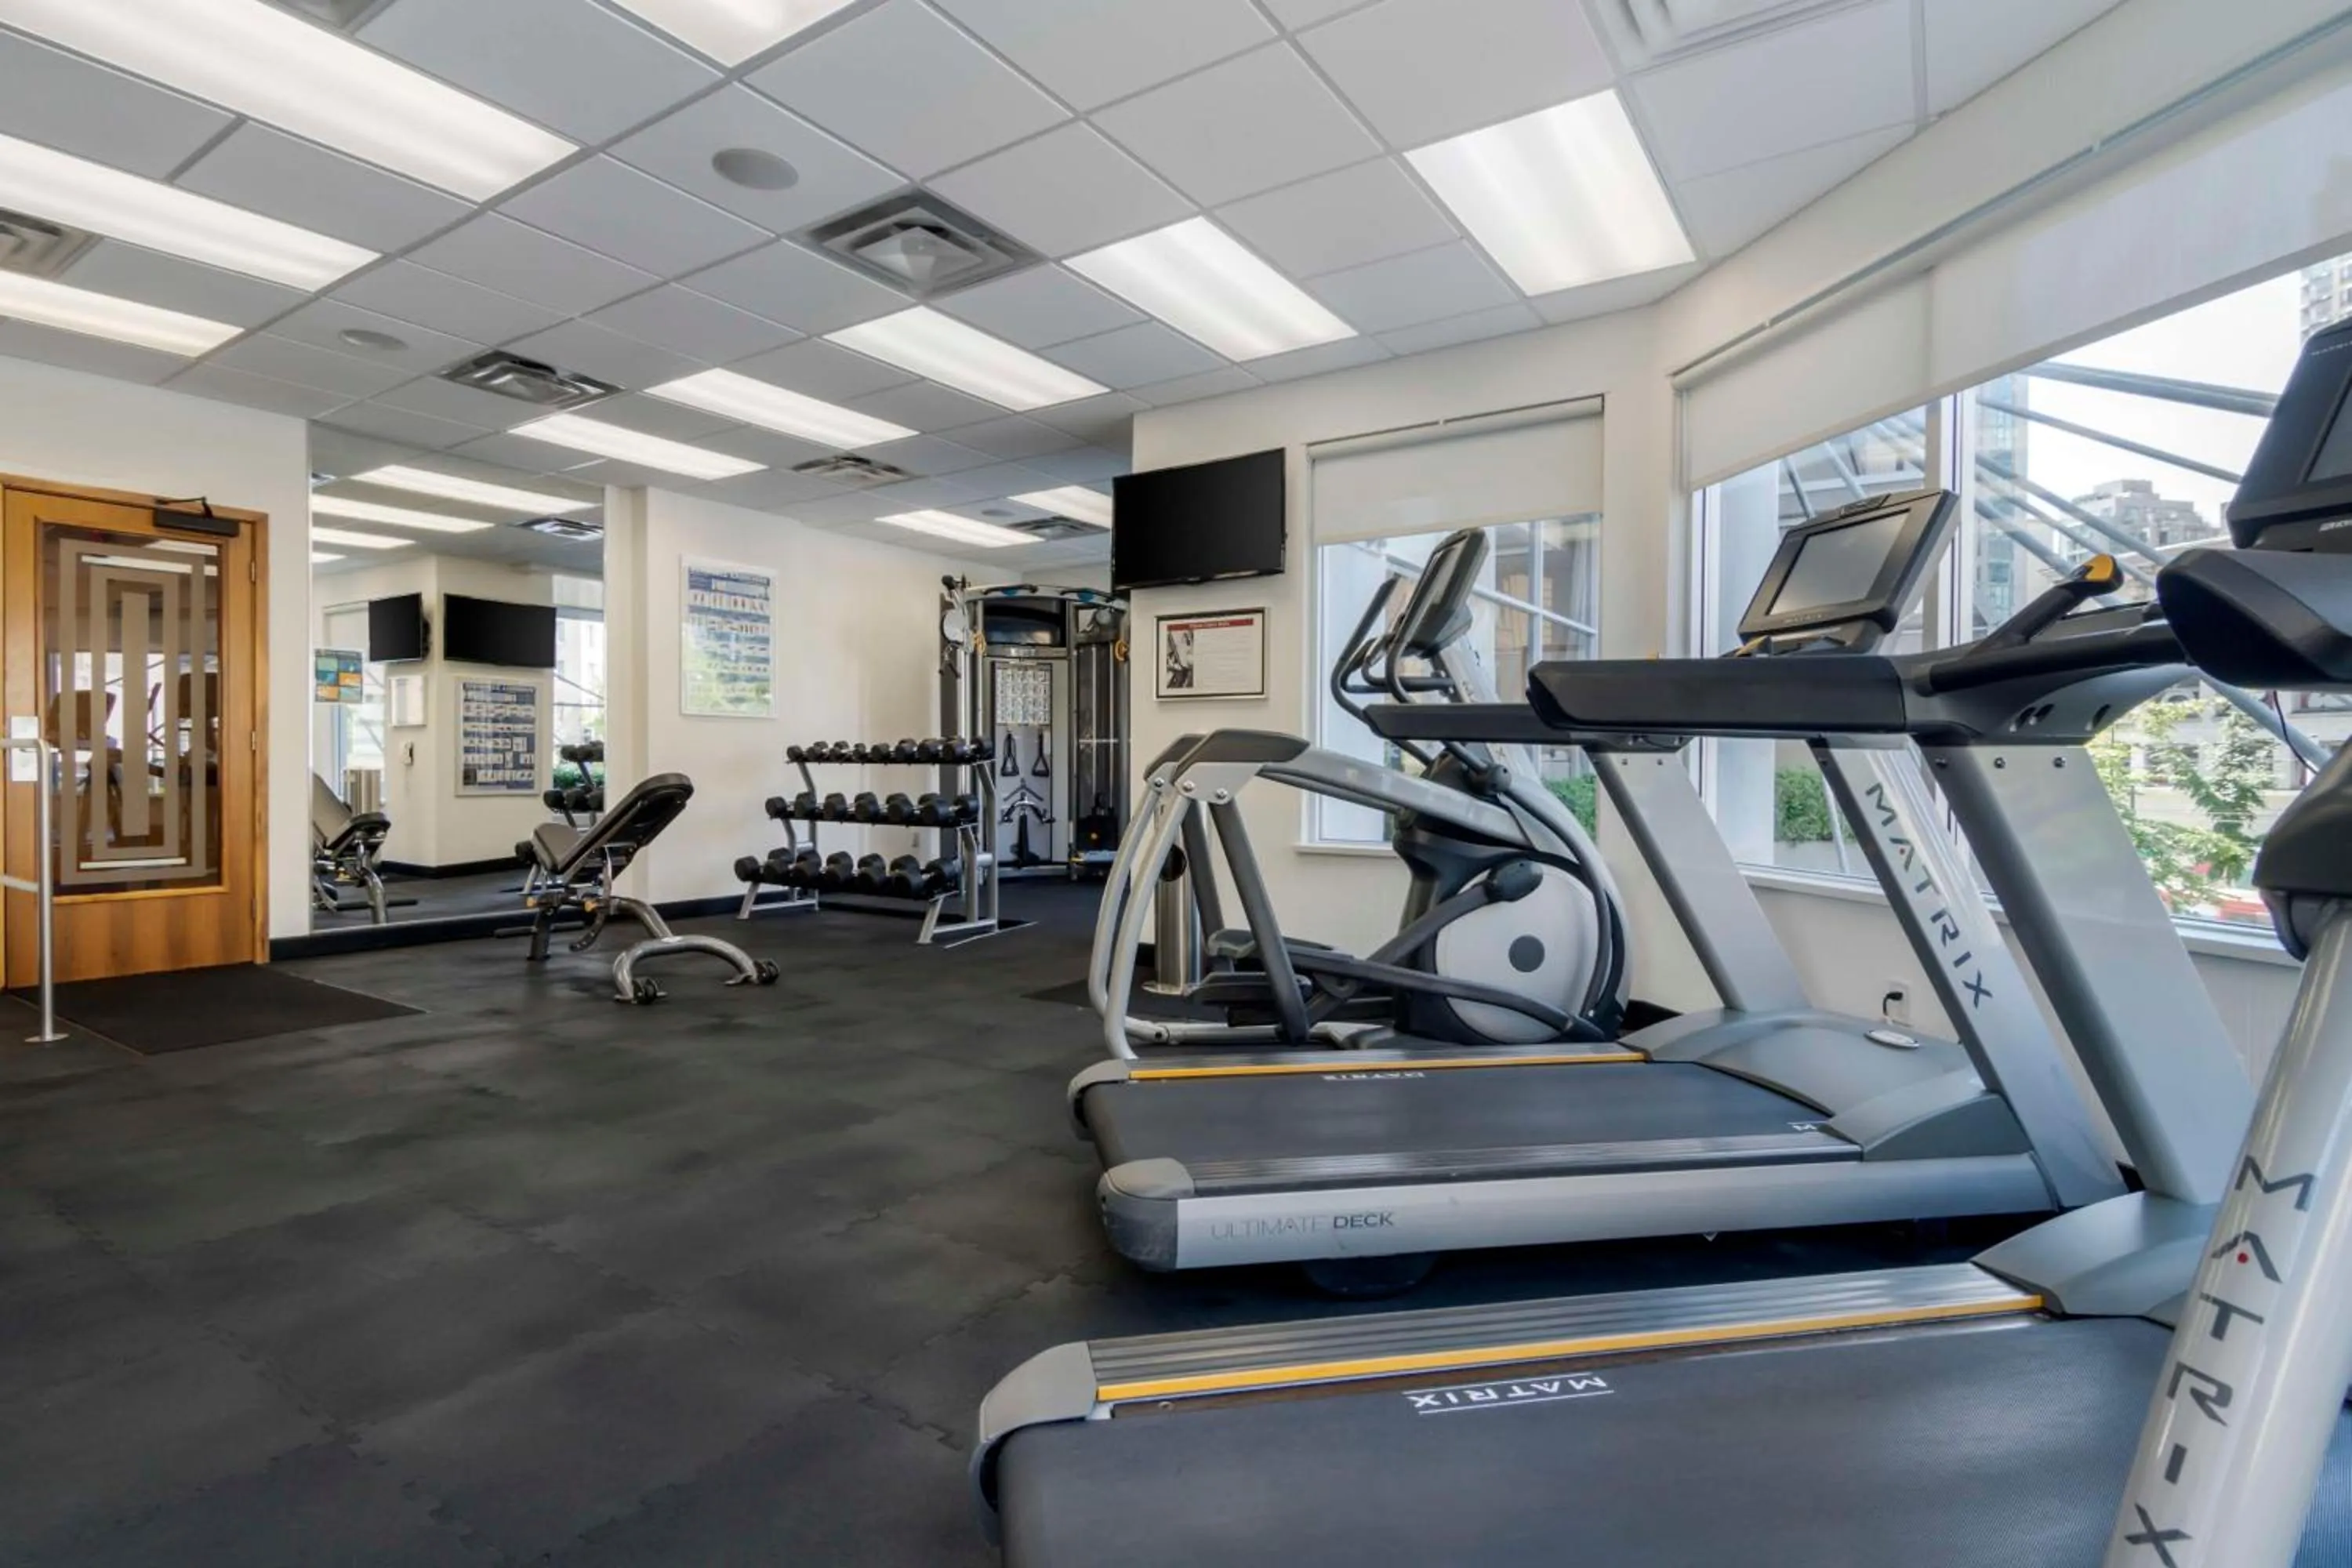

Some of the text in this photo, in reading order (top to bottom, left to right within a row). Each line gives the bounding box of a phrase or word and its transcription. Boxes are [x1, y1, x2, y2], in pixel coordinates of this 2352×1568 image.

[1865, 782, 1993, 1009] MATRIX
[1210, 1211, 1394, 1240] ULTIMATE DECK
[1407, 1376, 1607, 1408] MATRIX
[2124, 1154, 2318, 1568] MATRIX
